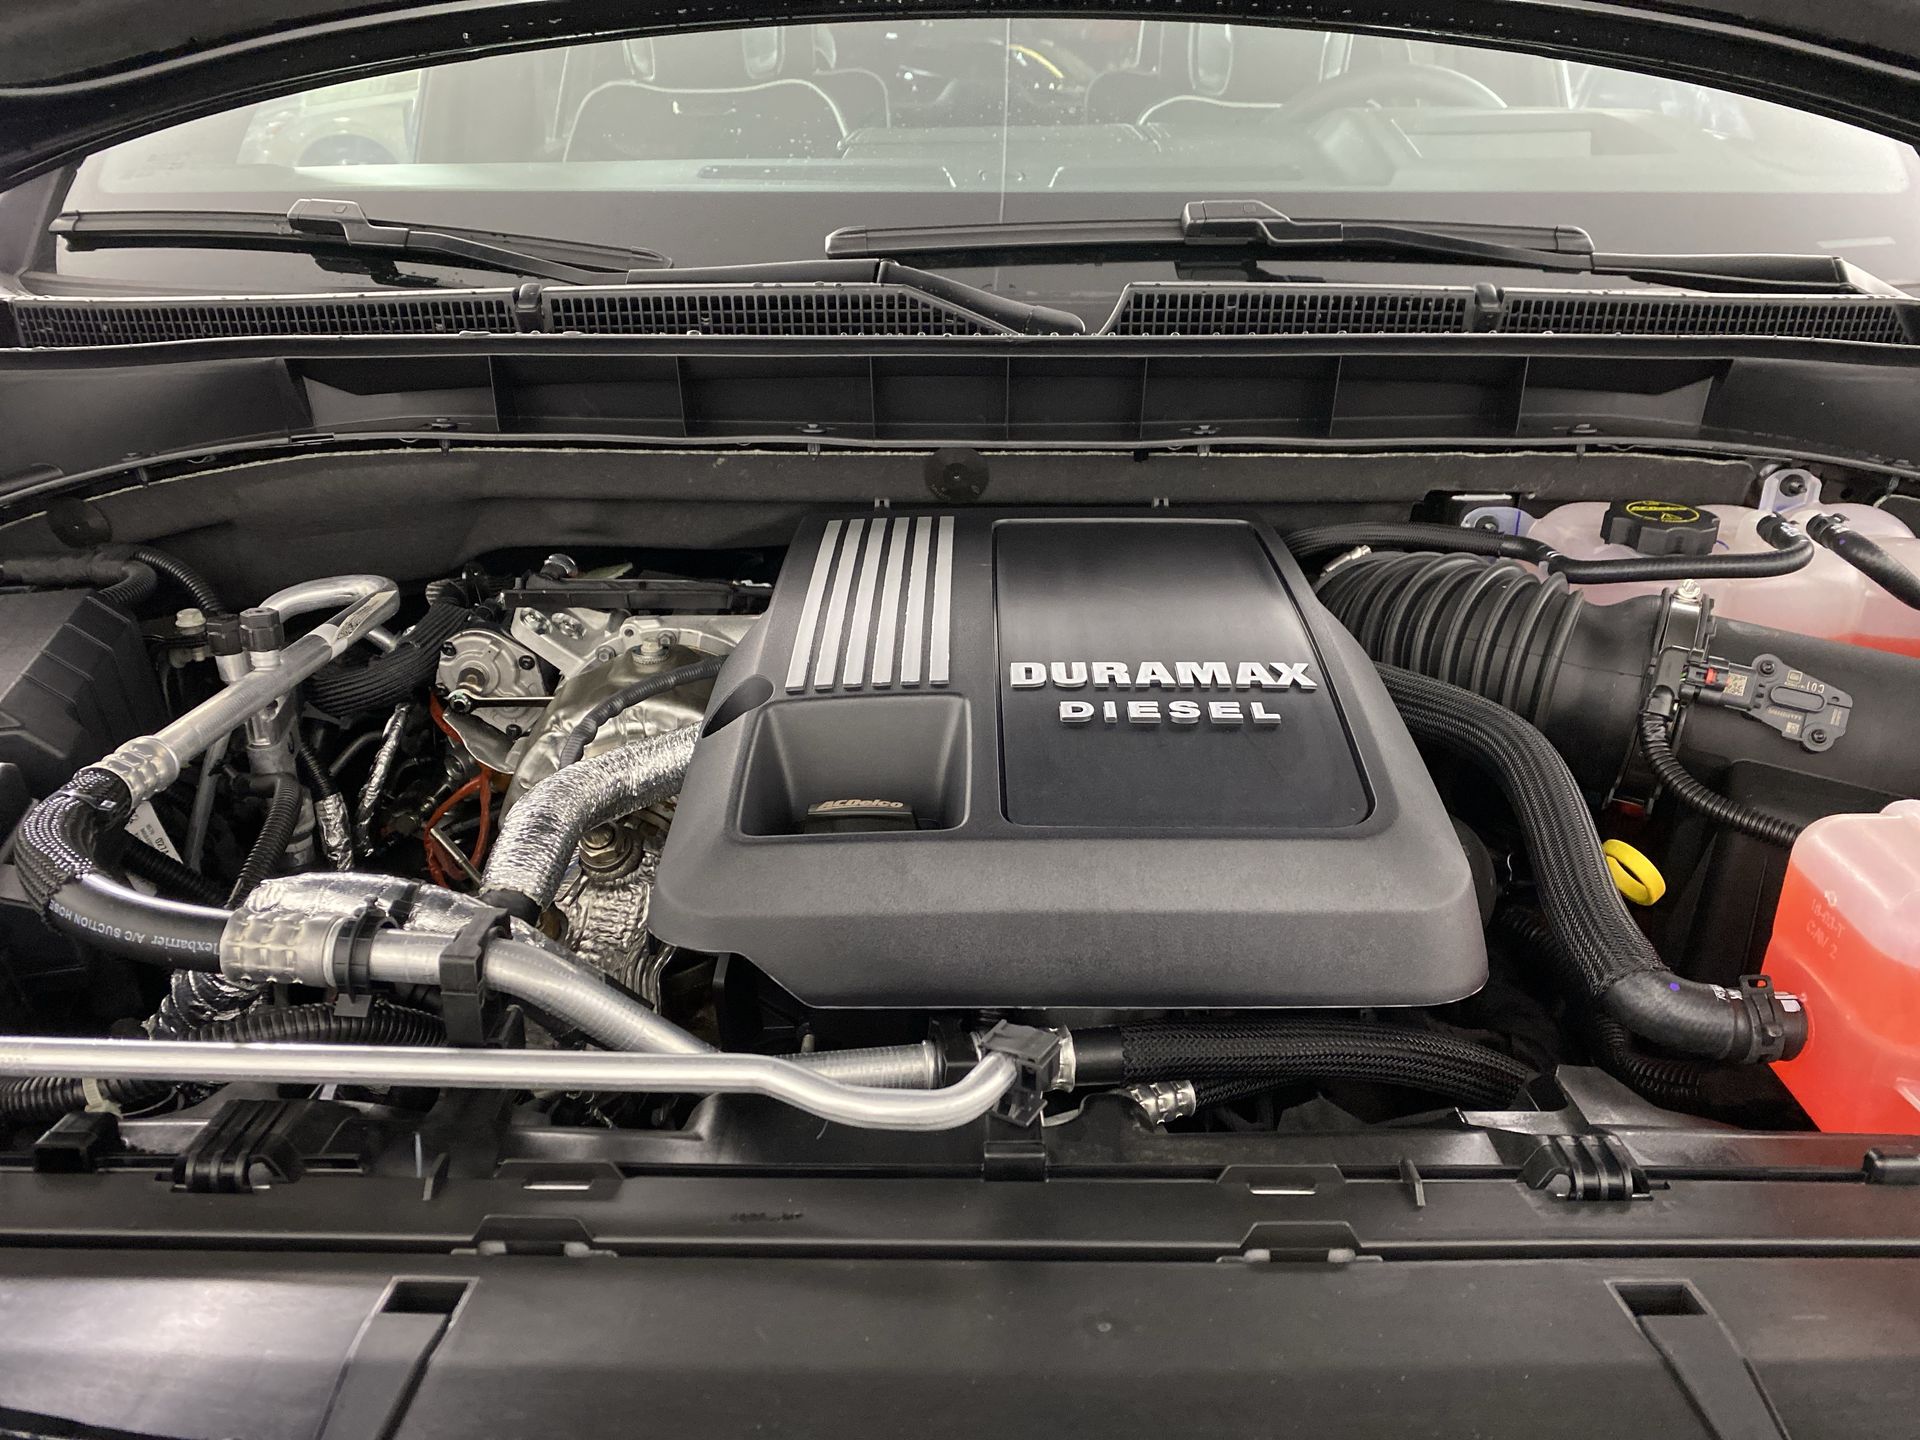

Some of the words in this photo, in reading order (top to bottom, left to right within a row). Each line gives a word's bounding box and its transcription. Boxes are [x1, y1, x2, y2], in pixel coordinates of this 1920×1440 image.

[1010, 661, 1317, 690] DURAMAX
[1059, 700, 1281, 724] DIESEL
[48, 898, 72, 921] HOSE
[73, 913, 121, 939] SUCTION
[124, 930, 146, 944] A/C
[151, 934, 220, 955] lexbarrier
